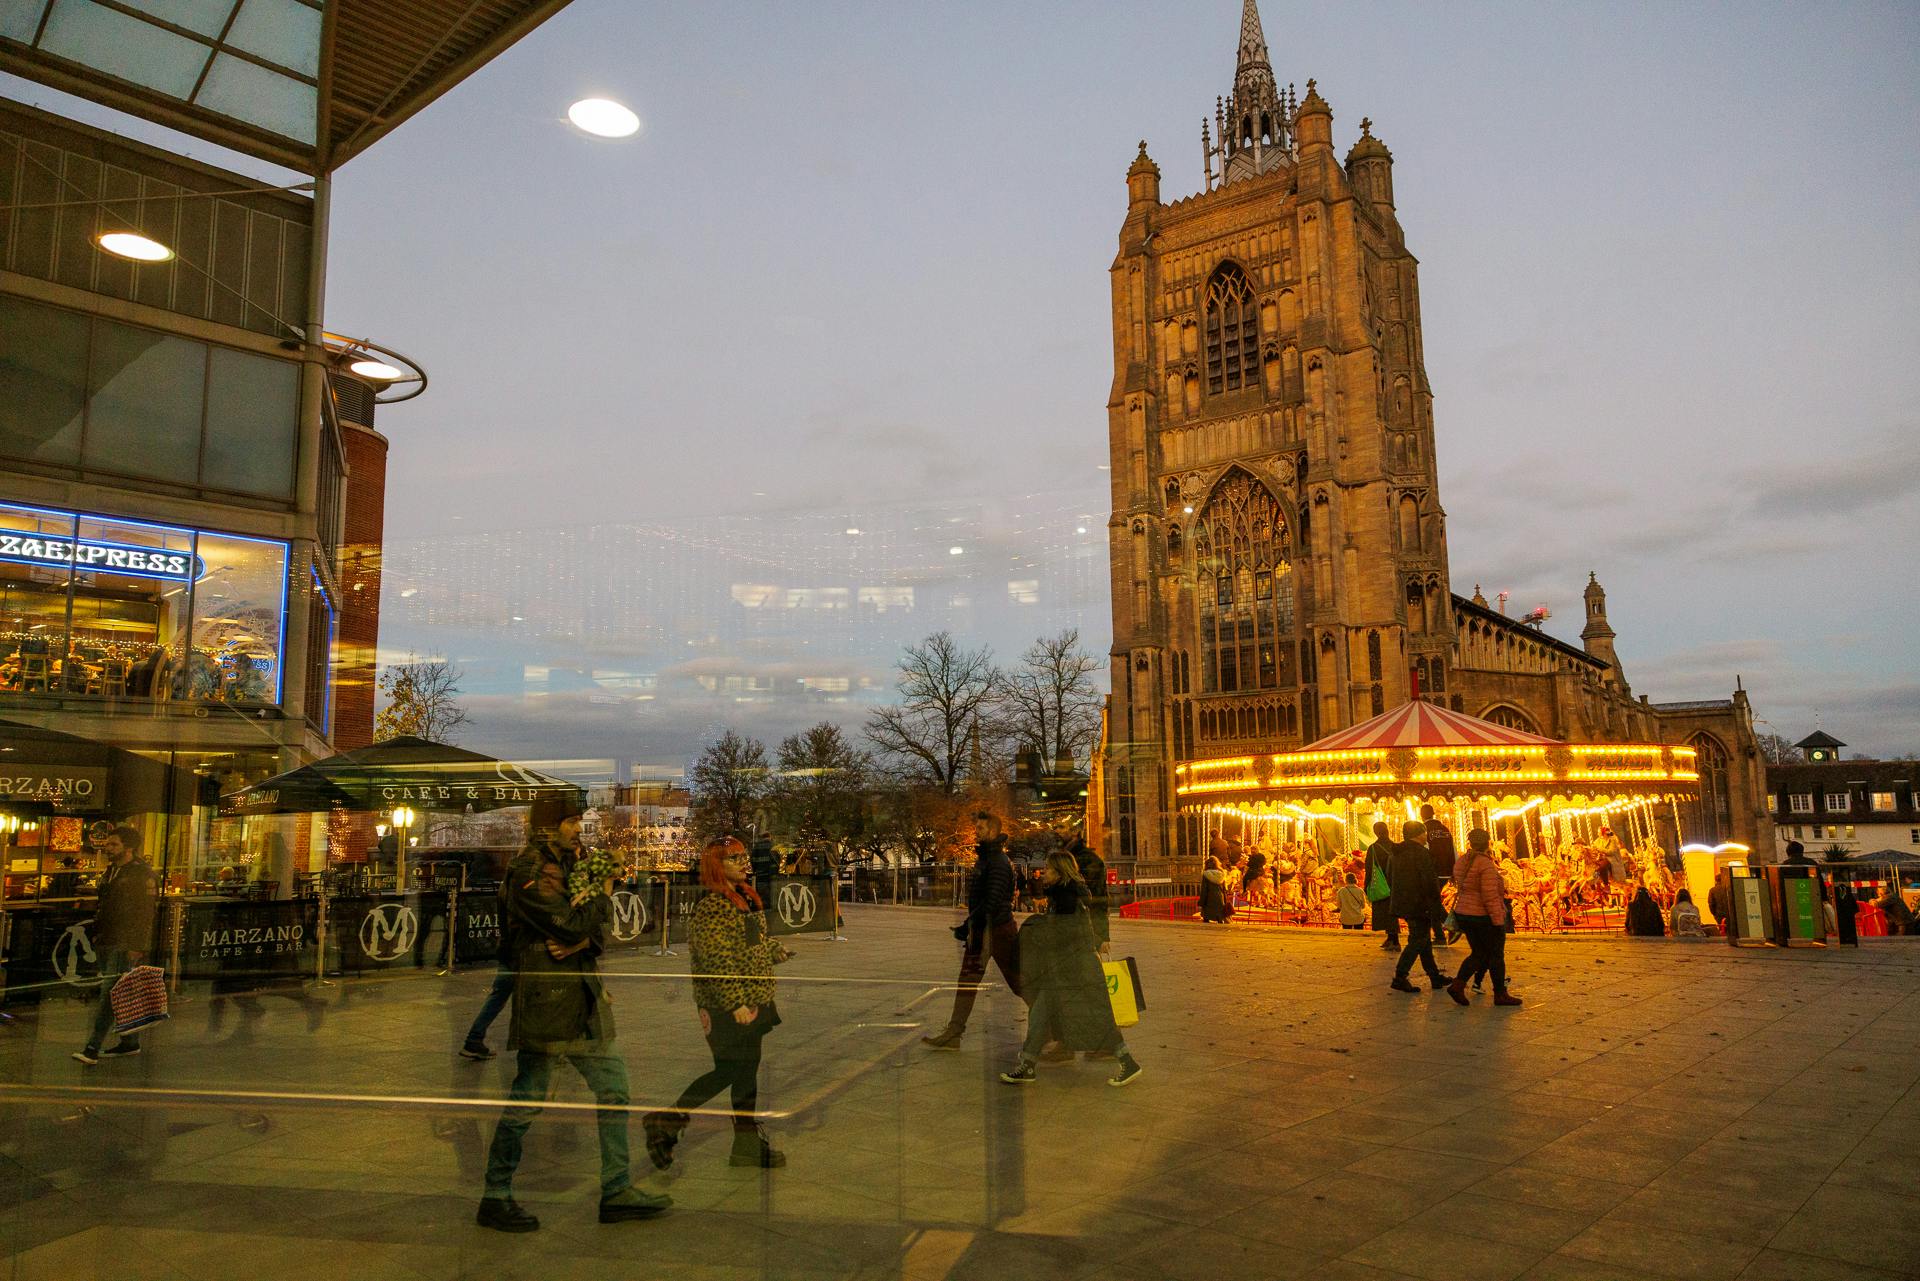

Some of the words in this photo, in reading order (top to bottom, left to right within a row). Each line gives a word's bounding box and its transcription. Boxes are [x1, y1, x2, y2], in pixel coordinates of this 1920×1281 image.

[382, 786, 450, 800] CAFE
[466, 786, 479, 799] &
[494, 787, 538, 801] BAR
[200, 925, 304, 947] MARZANO
[366, 907, 412, 956] M
[200, 947, 242, 958] CAFE
[255, 945, 263, 954] &
[276, 941, 303, 953] BAR
